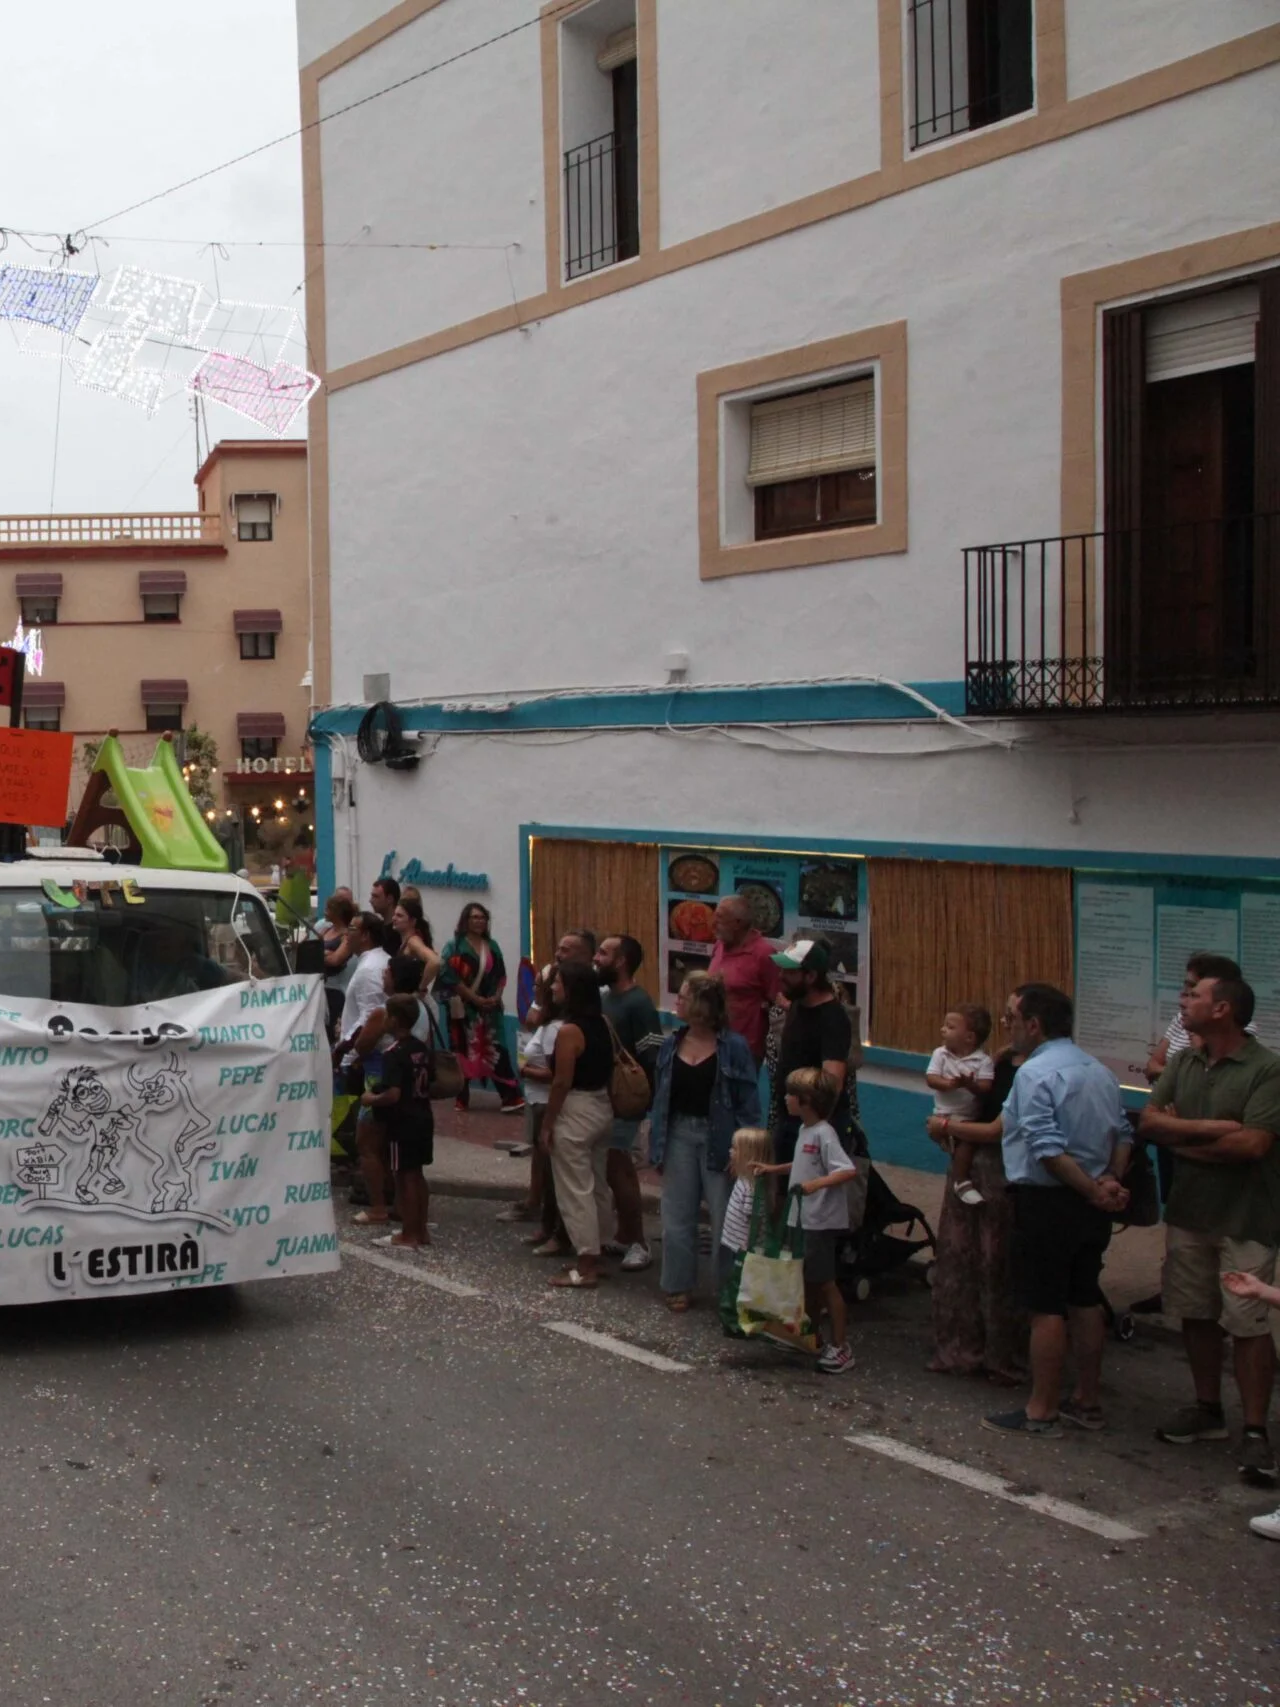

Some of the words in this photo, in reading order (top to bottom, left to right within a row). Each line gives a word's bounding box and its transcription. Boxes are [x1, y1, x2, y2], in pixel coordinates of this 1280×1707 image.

[236, 756, 311, 774] HOTEL
[239, 983, 309, 1009] DAMIAN
[188, 1023, 266, 1052] JUANTO
[218, 1064, 268, 1087] PEPE
[215, 1111, 278, 1136] LUCAS
[208, 1152, 259, 1182] IVÁN
